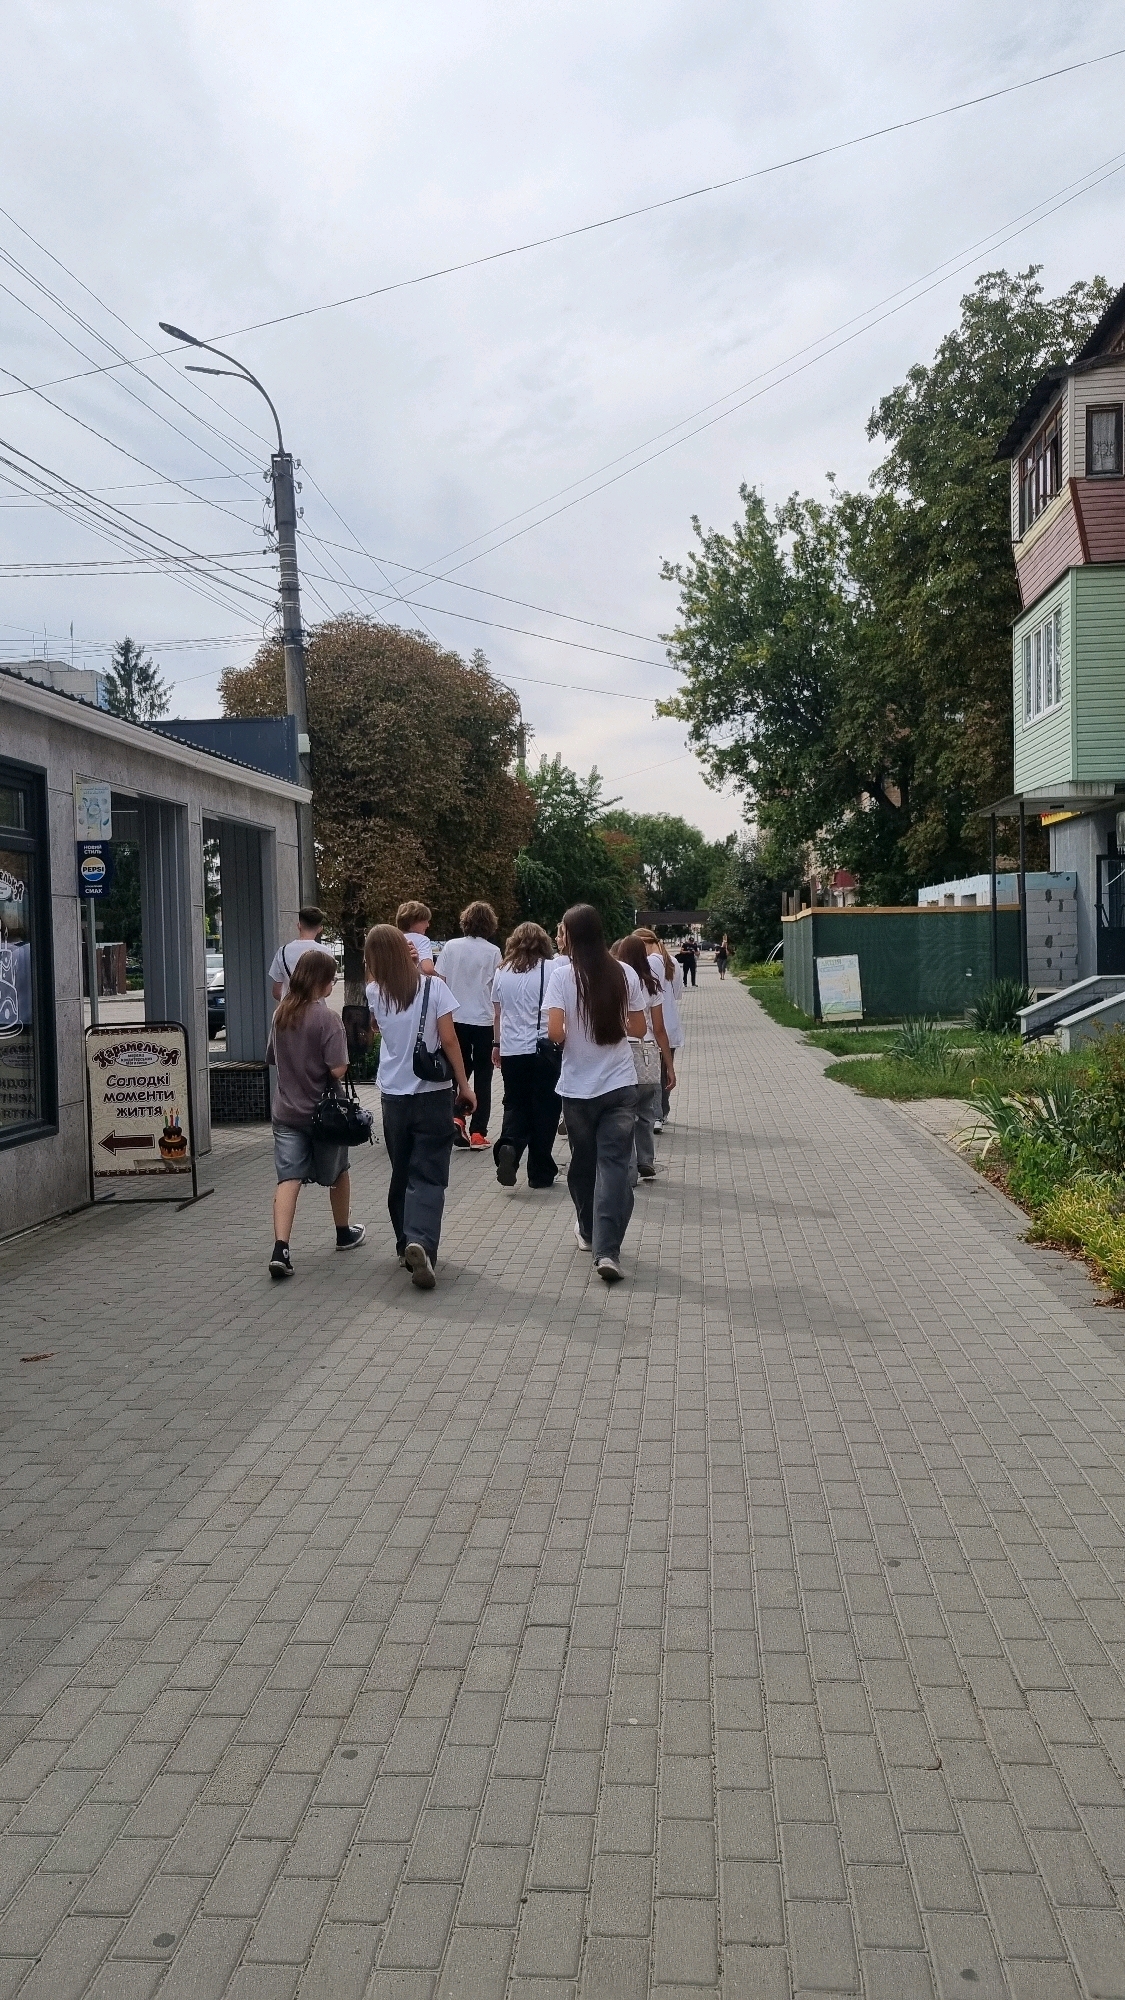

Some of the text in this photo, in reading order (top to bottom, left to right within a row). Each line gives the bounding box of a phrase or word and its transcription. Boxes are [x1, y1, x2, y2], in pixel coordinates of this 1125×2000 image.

[106, 1072, 170, 1087] Солодкі
[103, 1090, 175, 1102] моменти
[116, 1106, 163, 1117] життя
